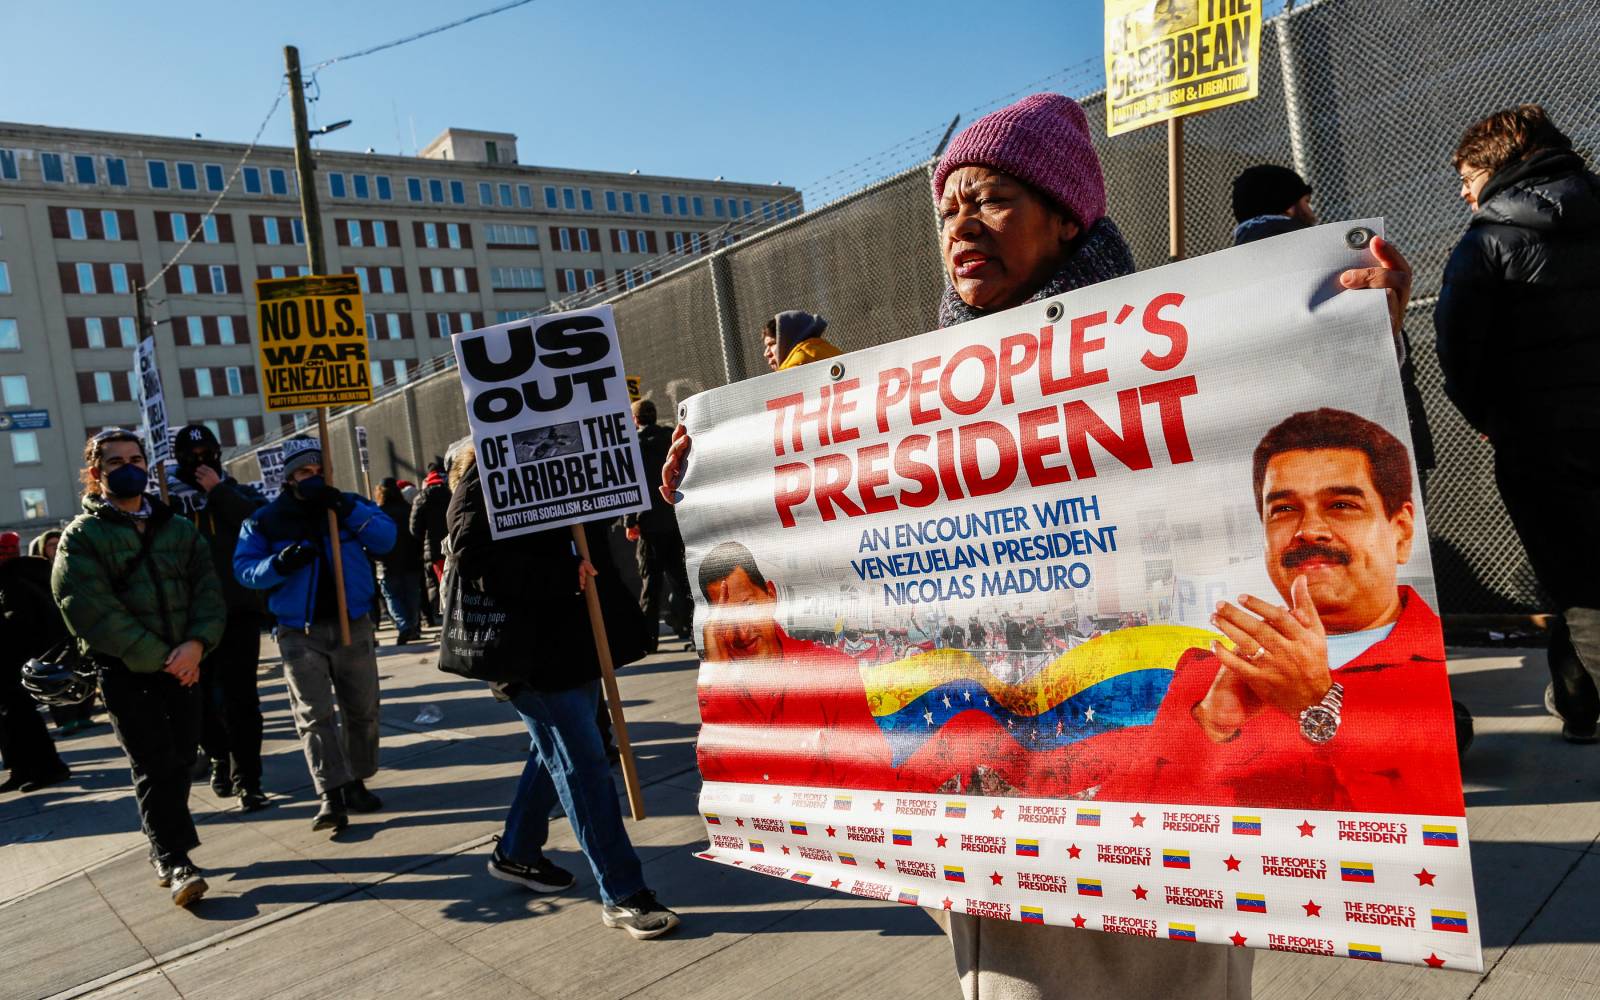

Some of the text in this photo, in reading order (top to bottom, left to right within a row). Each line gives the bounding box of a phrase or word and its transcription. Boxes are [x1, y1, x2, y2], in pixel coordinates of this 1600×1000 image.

[1112, 16, 1251, 100] CARIBBEAN
[1186, 86, 1198, 100] &
[1198, 72, 1248, 98] LIBERATION
[261, 298, 364, 342] NO U.S.
[262, 343, 366, 366] WAR
[460, 316, 610, 383] US
[264, 363, 368, 393] VENEZUELA
[766, 292, 1188, 457] THE PEOPLE'S
[337, 391, 368, 402] LIBERATION
[473, 366, 616, 423] OUT
[481, 412, 631, 470] OF THE
[774, 374, 1198, 529] PRESIDENT
[487, 446, 637, 510] CARIBBEAN
[497, 489, 640, 528] PARTY FOR SOCIALISM & LIBERATION
[859, 495, 1100, 553] AN ENCOUNTER WITH
[851, 526, 1118, 581] VENEZUELAN PRESIDENT
[884, 562, 1091, 606] NICOLAS MADURO
[792, 792, 802, 801] THE
[896, 798, 938, 808] THE PEOPLE'S
[792, 799, 827, 809] PRESIDENT
[895, 806, 936, 816] PRESIDENT
[1018, 805, 1067, 816] THE PEOPLE'S
[1018, 814, 1066, 825] PRESIDENT
[1162, 812, 1220, 824] THE PEOPLE'S
[847, 825, 857, 834] THE
[1162, 821, 1220, 834] PRESIDENT
[1337, 820, 1407, 833] THE PEOPLE'S
[848, 833, 885, 844] PRESIDENT
[961, 834, 1006, 845] THE PEOPLE'S
[1338, 830, 1408, 845] PRESIDENT
[961, 842, 1006, 855] PRESIDENT
[1097, 844, 1151, 857] THE PEOPLE'S
[800, 852, 834, 863] PRESIDENT
[1097, 854, 1151, 867] PRESIDENT
[1261, 856, 1326, 870] THE PEOPLE'S
[896, 859, 936, 871] THE PEOPLE'S
[898, 867, 936, 879] PRESIDENT
[1017, 872, 1067, 885] THE PEOPLE'S
[1262, 866, 1326, 880] PRESIDENT
[1018, 881, 1067, 894] PRESIDENT
[1164, 885, 1224, 900] THE PEOPLE'S
[966, 898, 978, 908] THE
[1165, 895, 1224, 910] PRESIDENT
[1344, 901, 1415, 916] THE PEOPLE'S
[967, 907, 1011, 922] PRESIDENT
[1345, 912, 1416, 928] PRESIDENT
[1102, 914, 1157, 930] THE PEOPLE'S
[1268, 933, 1334, 951] THE PEOPLE'S
